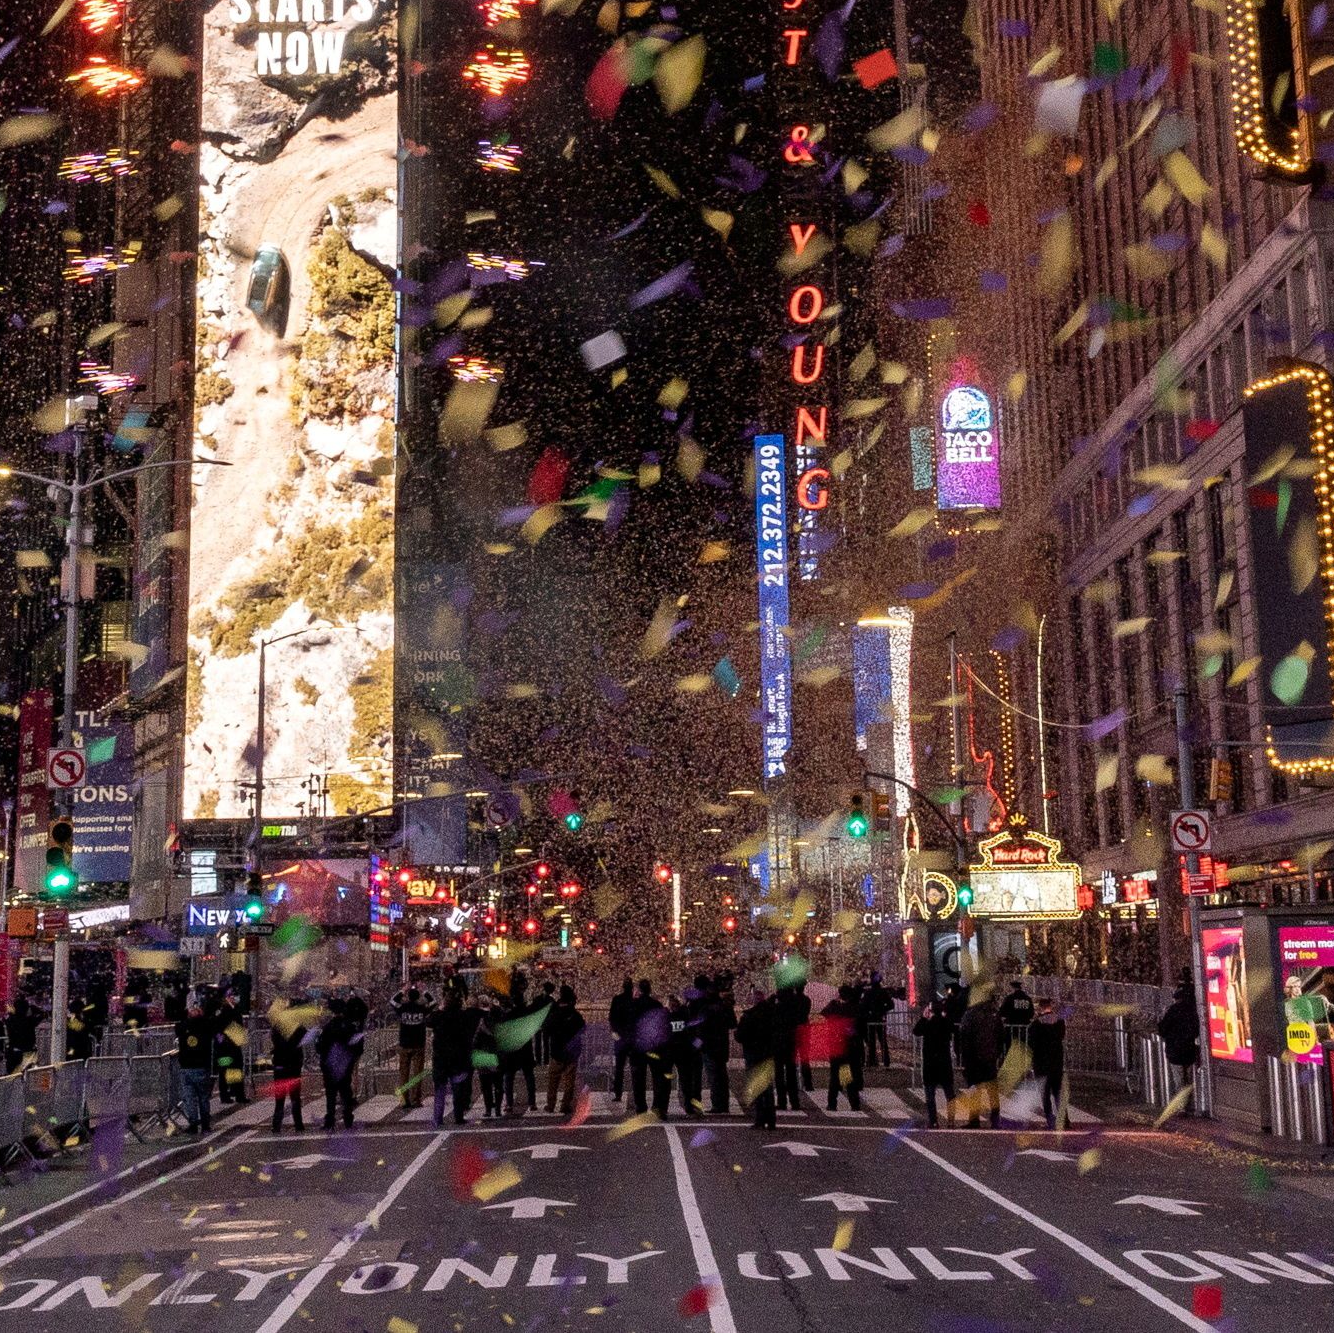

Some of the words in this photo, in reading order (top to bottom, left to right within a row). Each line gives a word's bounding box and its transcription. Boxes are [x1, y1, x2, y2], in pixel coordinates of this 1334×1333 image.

[256, 32, 346, 76] NOW
[788, 223, 831, 512] YOUNG
[942, 431, 993, 448] TACO
[945, 447, 992, 464] BELL
[760, 444, 784, 587] 212.372.2349
[994, 848, 1019, 862] Hard
[1020, 848, 1046, 862] Rock
[189, 903, 230, 926] NEW
[1283, 939, 1316, 949] stream
[1284, 950, 1297, 960] for
[1298, 950, 1318, 960] free
[342, 1251, 667, 1295] ONLY
[736, 1246, 1038, 1281] ONLY
